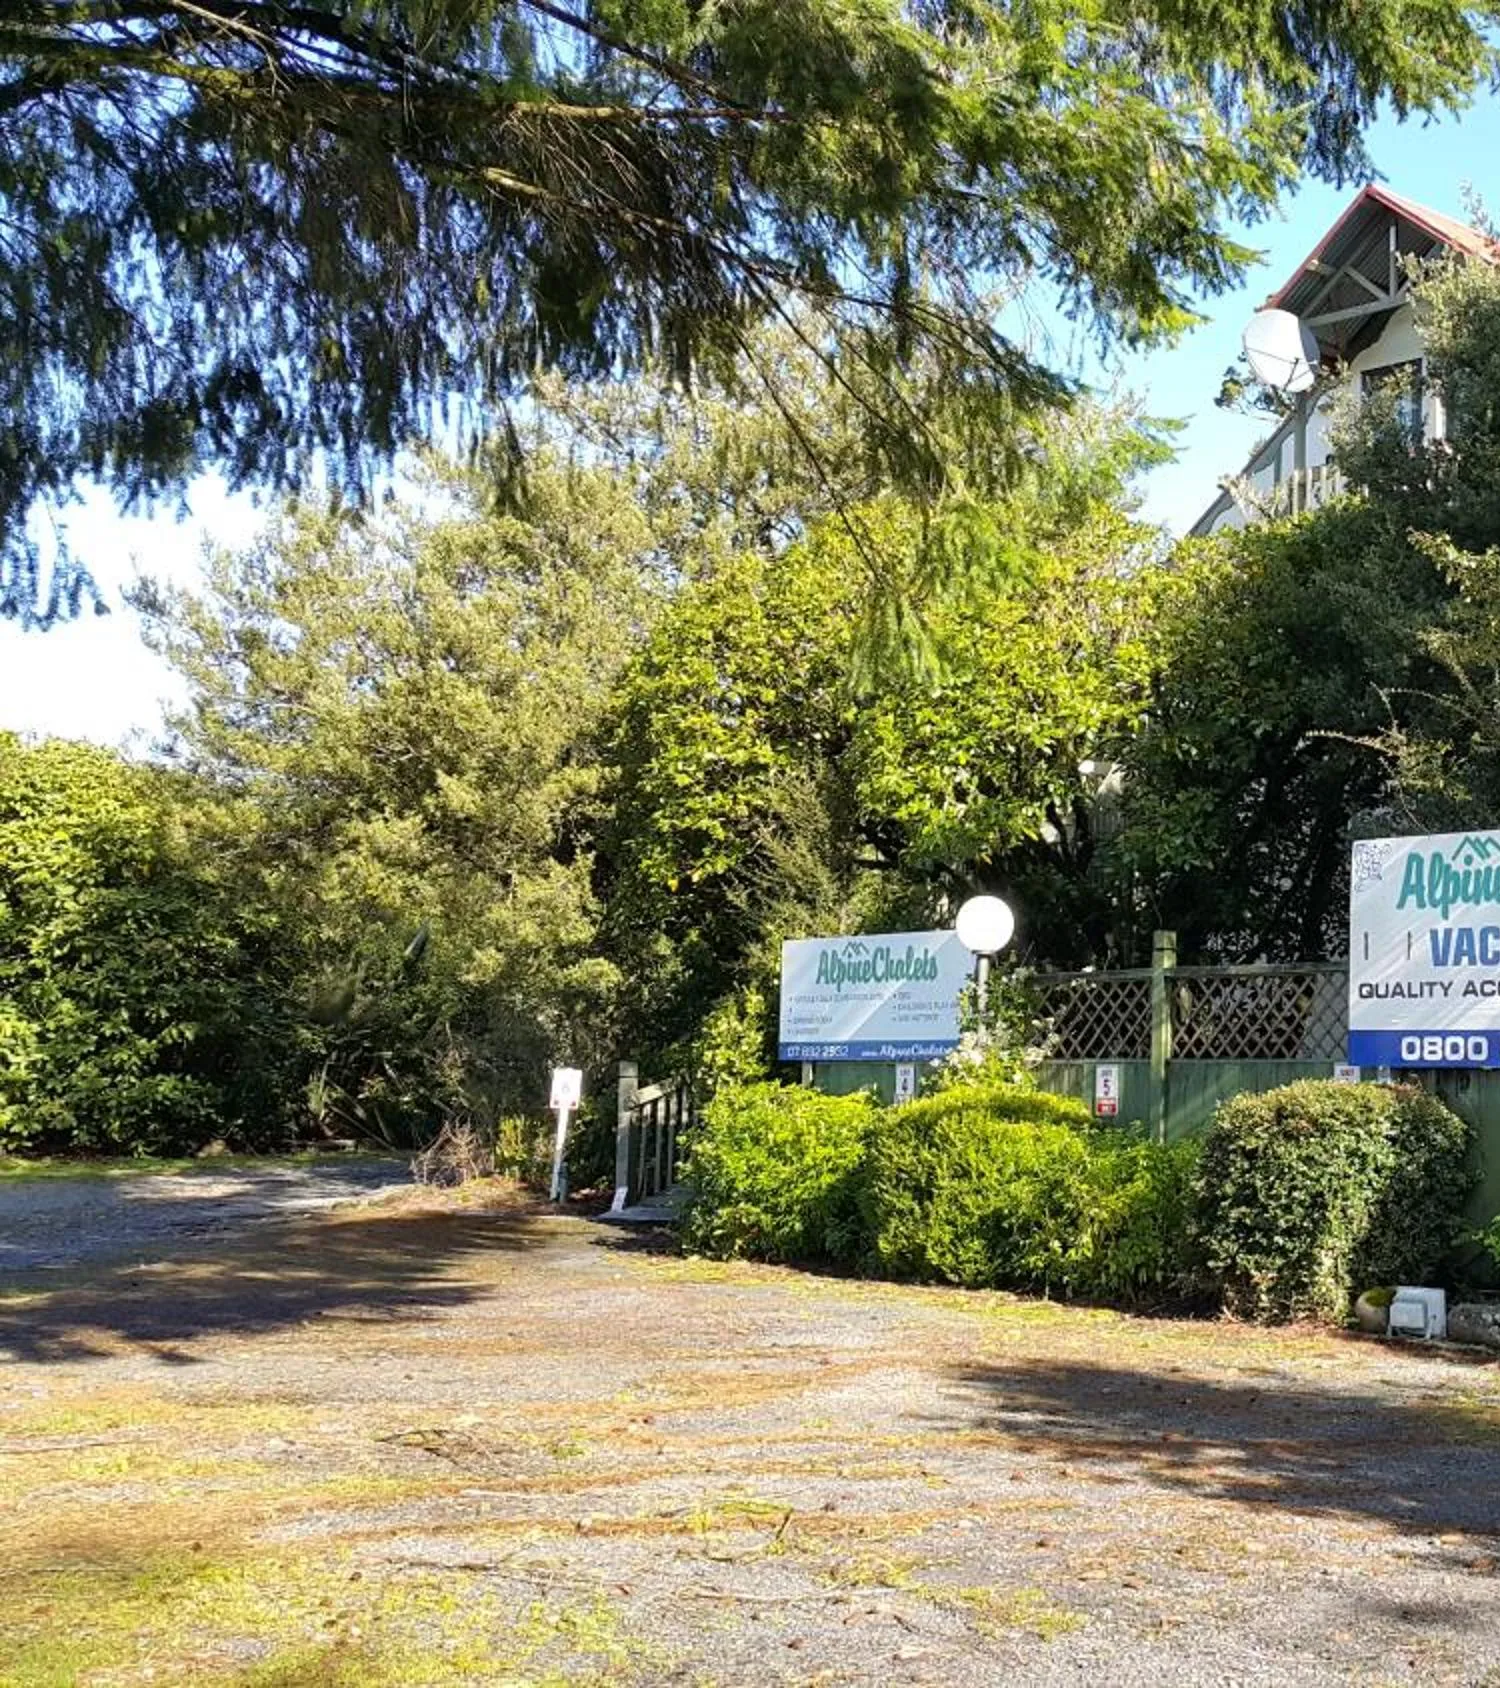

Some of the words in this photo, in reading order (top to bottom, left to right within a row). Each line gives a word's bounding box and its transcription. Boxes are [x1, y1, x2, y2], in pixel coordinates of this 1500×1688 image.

[1358, 980, 1454, 999] QUALITY
[1400, 1035, 1489, 1062] 0800
[1103, 1077, 1112, 1096] 5
